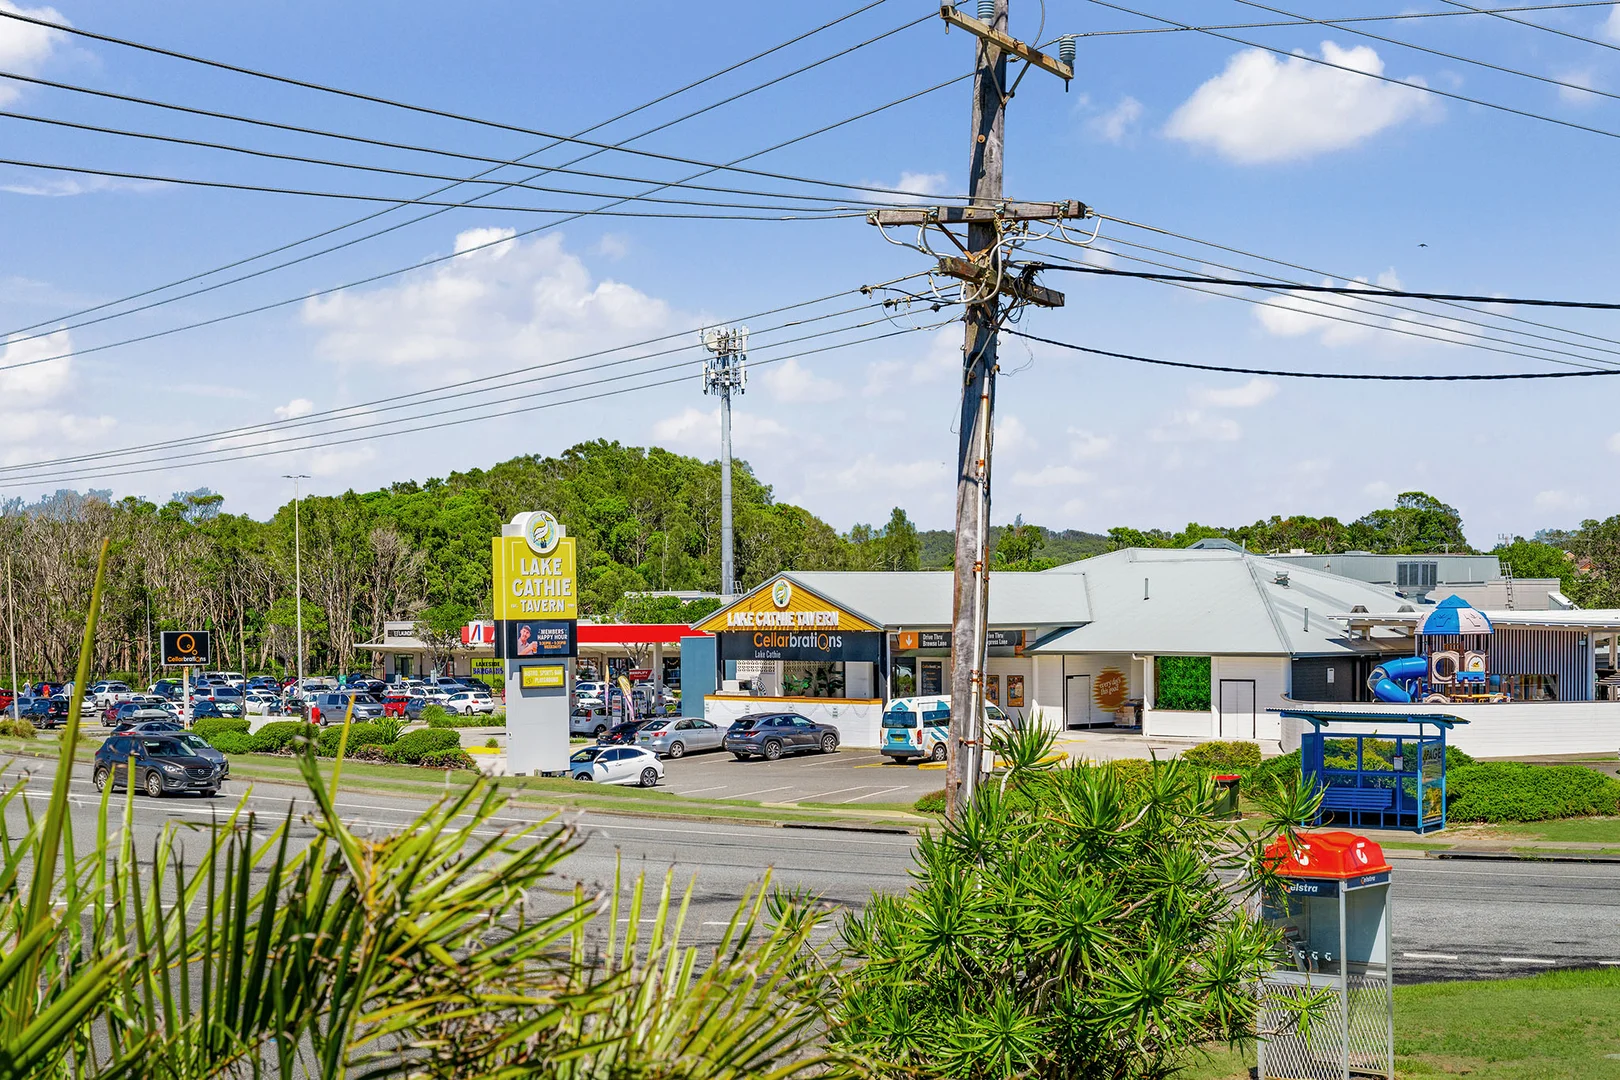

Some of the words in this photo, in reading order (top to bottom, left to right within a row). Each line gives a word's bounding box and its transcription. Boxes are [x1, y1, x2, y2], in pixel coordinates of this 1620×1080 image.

[521, 558, 562, 576] LAKE
[512, 578, 572, 597] CATHIE
[520, 599, 565, 612] TAVERN
[727, 611, 754, 627] LAKE
[755, 611, 795, 627] CATHIE
[796, 611, 839, 627] TAVERN
[755, 650, 765, 658] Lake
[766, 650, 781, 658] Cathie
[1109, 684, 1119, 695] good
